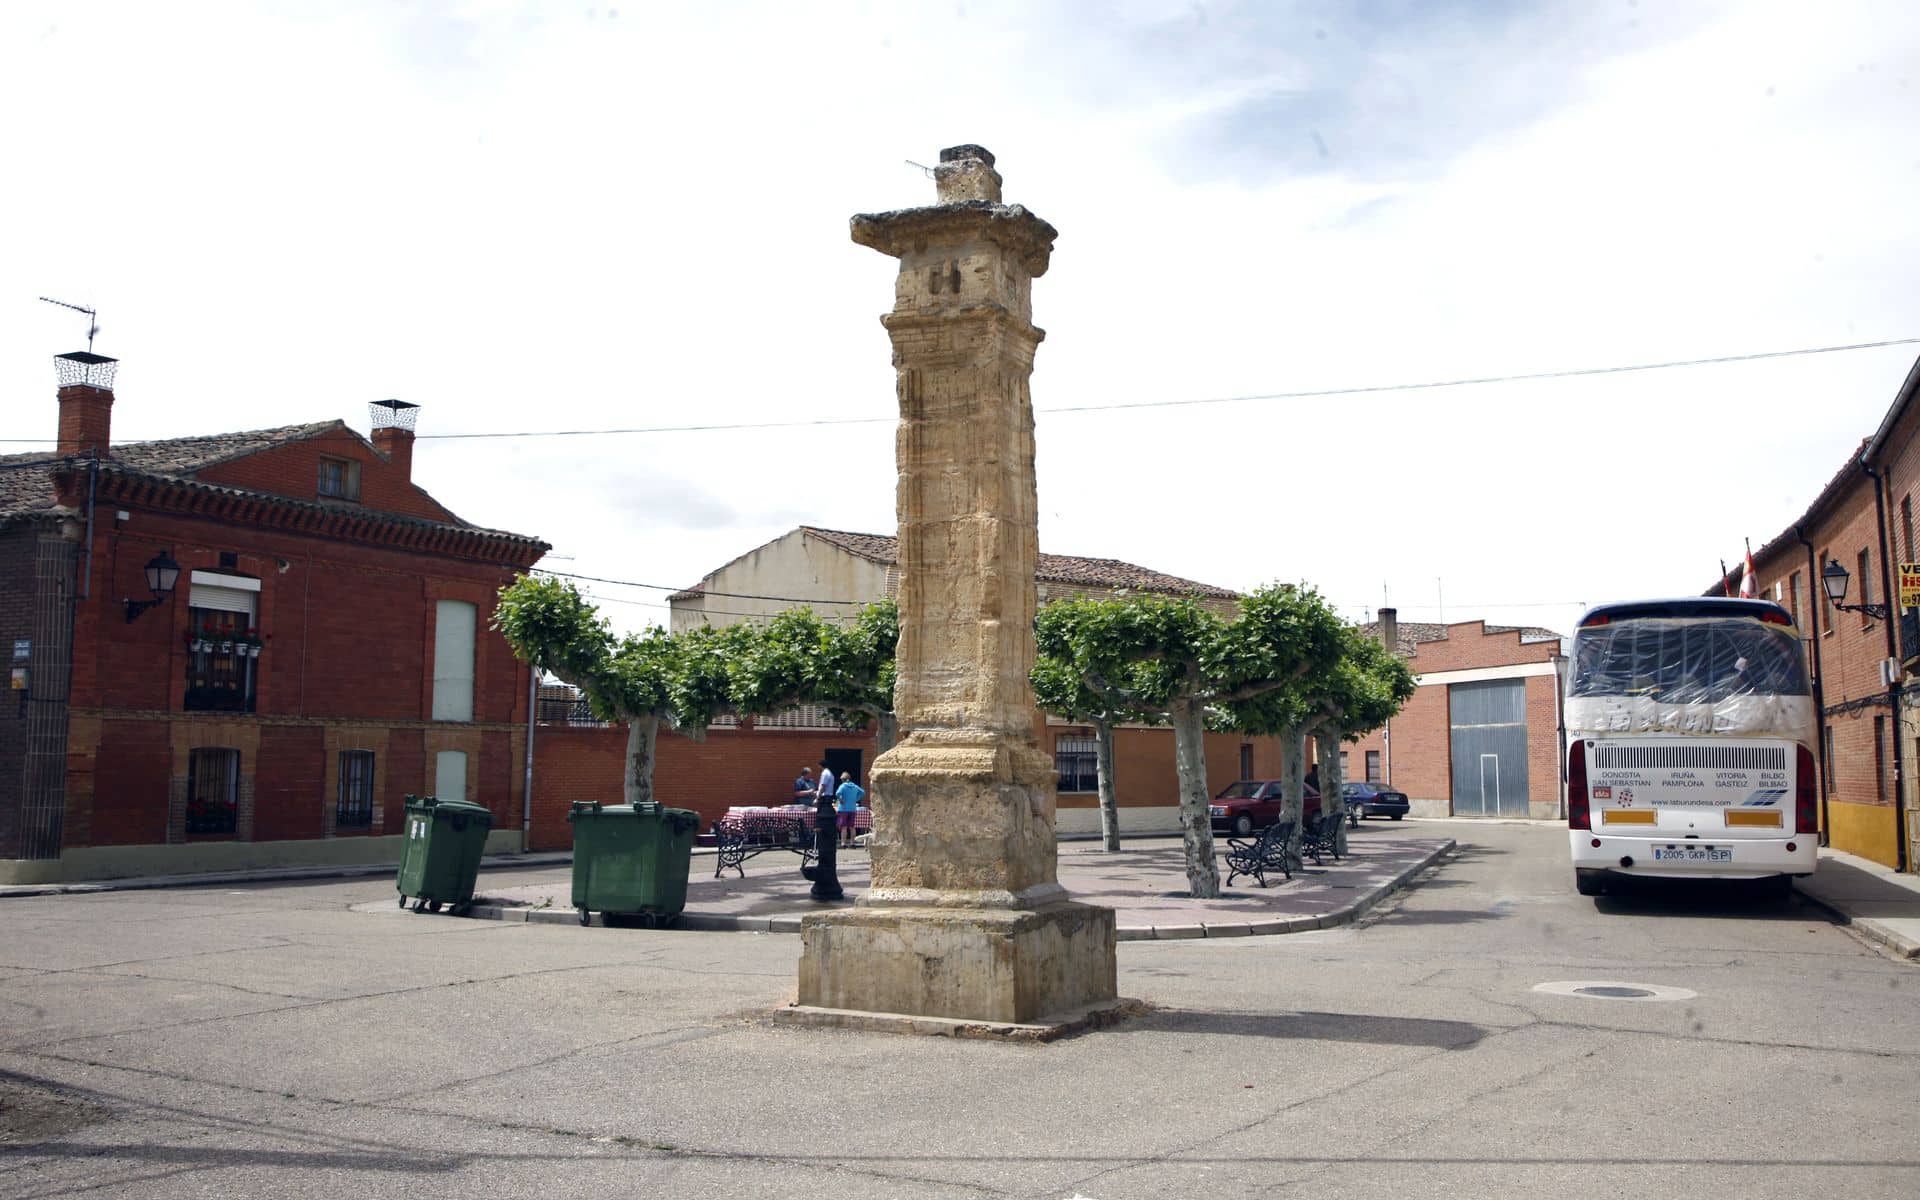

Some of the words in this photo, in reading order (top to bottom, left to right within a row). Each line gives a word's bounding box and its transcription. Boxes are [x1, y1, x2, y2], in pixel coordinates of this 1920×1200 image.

[1671, 771, 1695, 779] IRUÑA
[1715, 780, 1748, 788] GASTEIZ
[1759, 780, 1788, 788] BILBAO
[1663, 850, 1685, 860] 2005
[1689, 850, 1705, 860] GKR
[1711, 851, 1729, 860] SP
